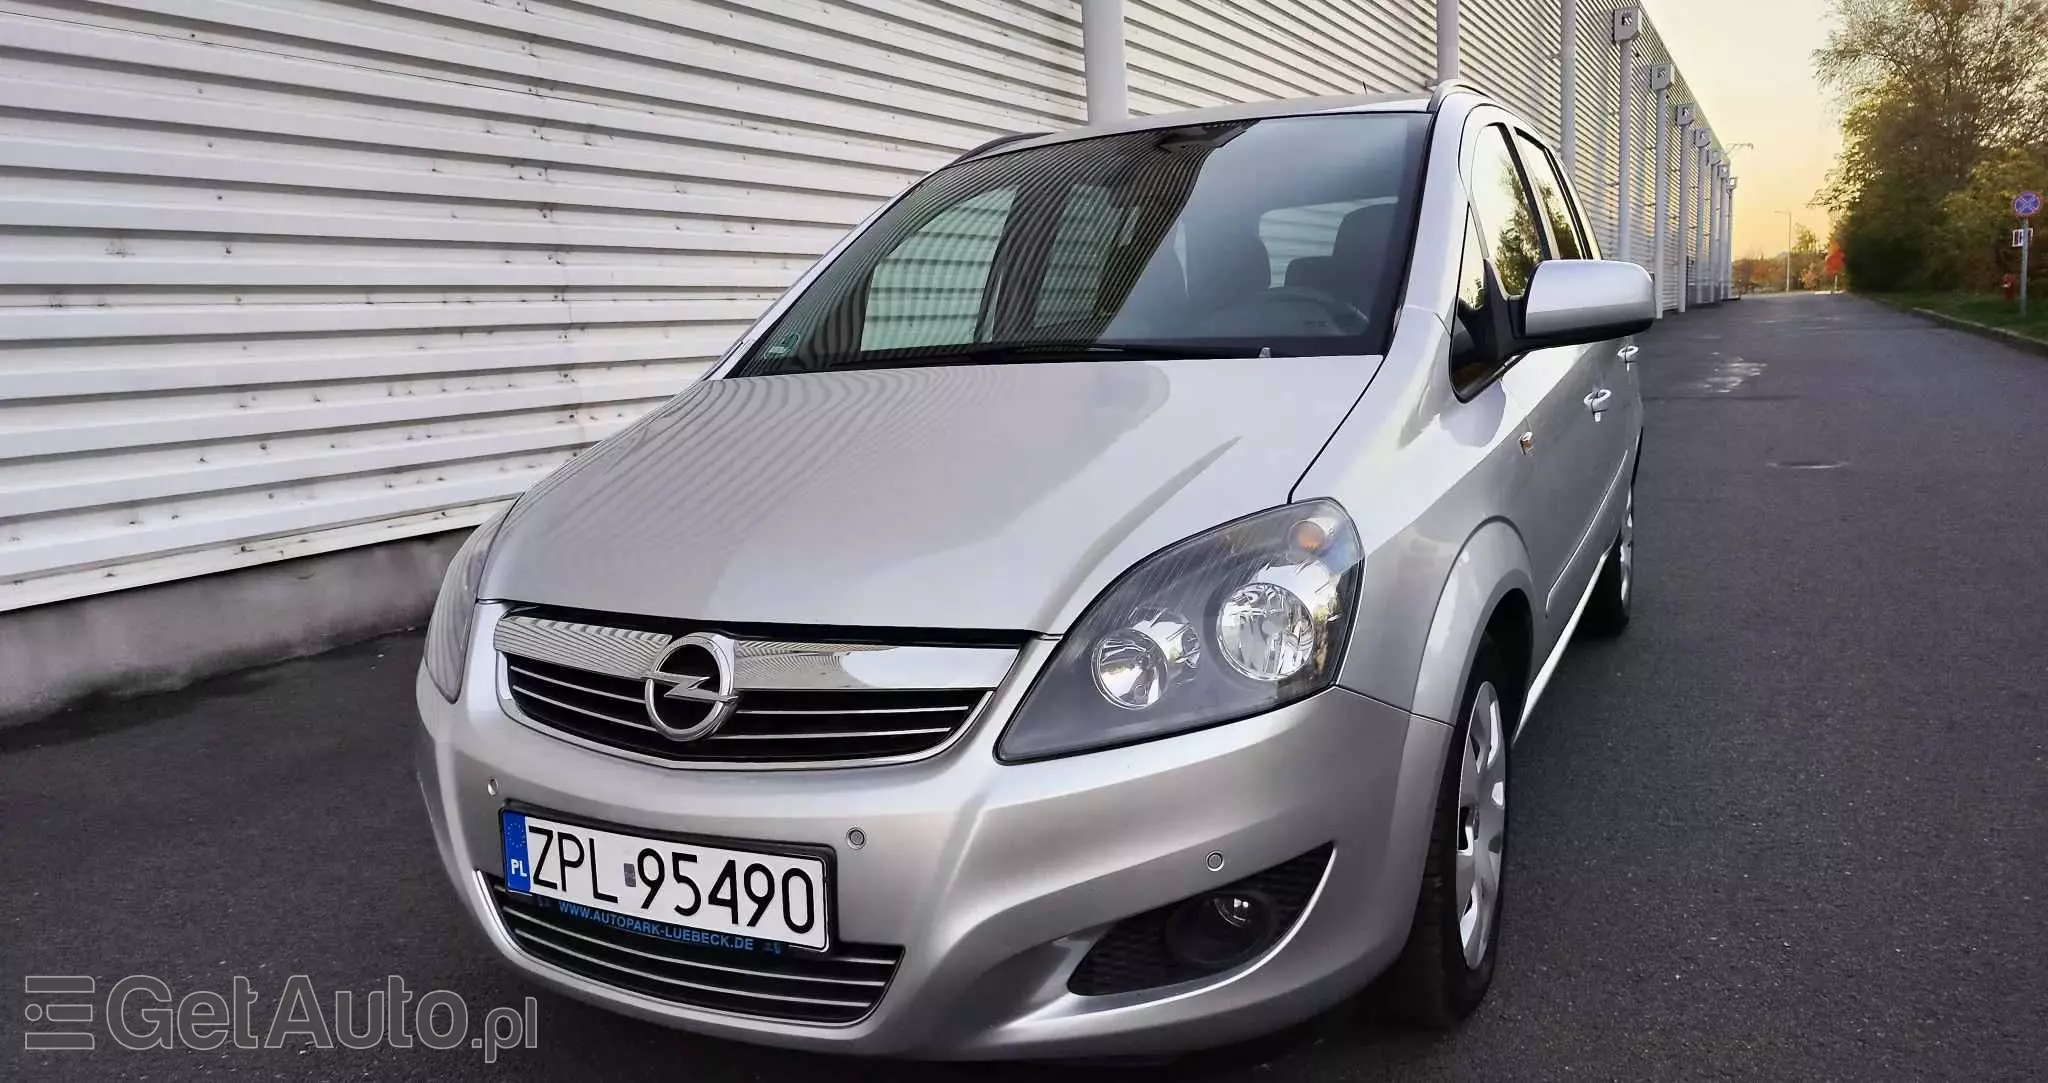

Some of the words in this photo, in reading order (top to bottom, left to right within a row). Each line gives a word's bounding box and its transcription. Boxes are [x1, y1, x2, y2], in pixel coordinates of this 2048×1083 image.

[510, 858, 528, 877] PL
[528, 825, 619, 904] ZPL
[637, 847, 815, 935] 95490
[558, 901, 755, 951] WWW.AUTOPARK-LUEBECK.DE
